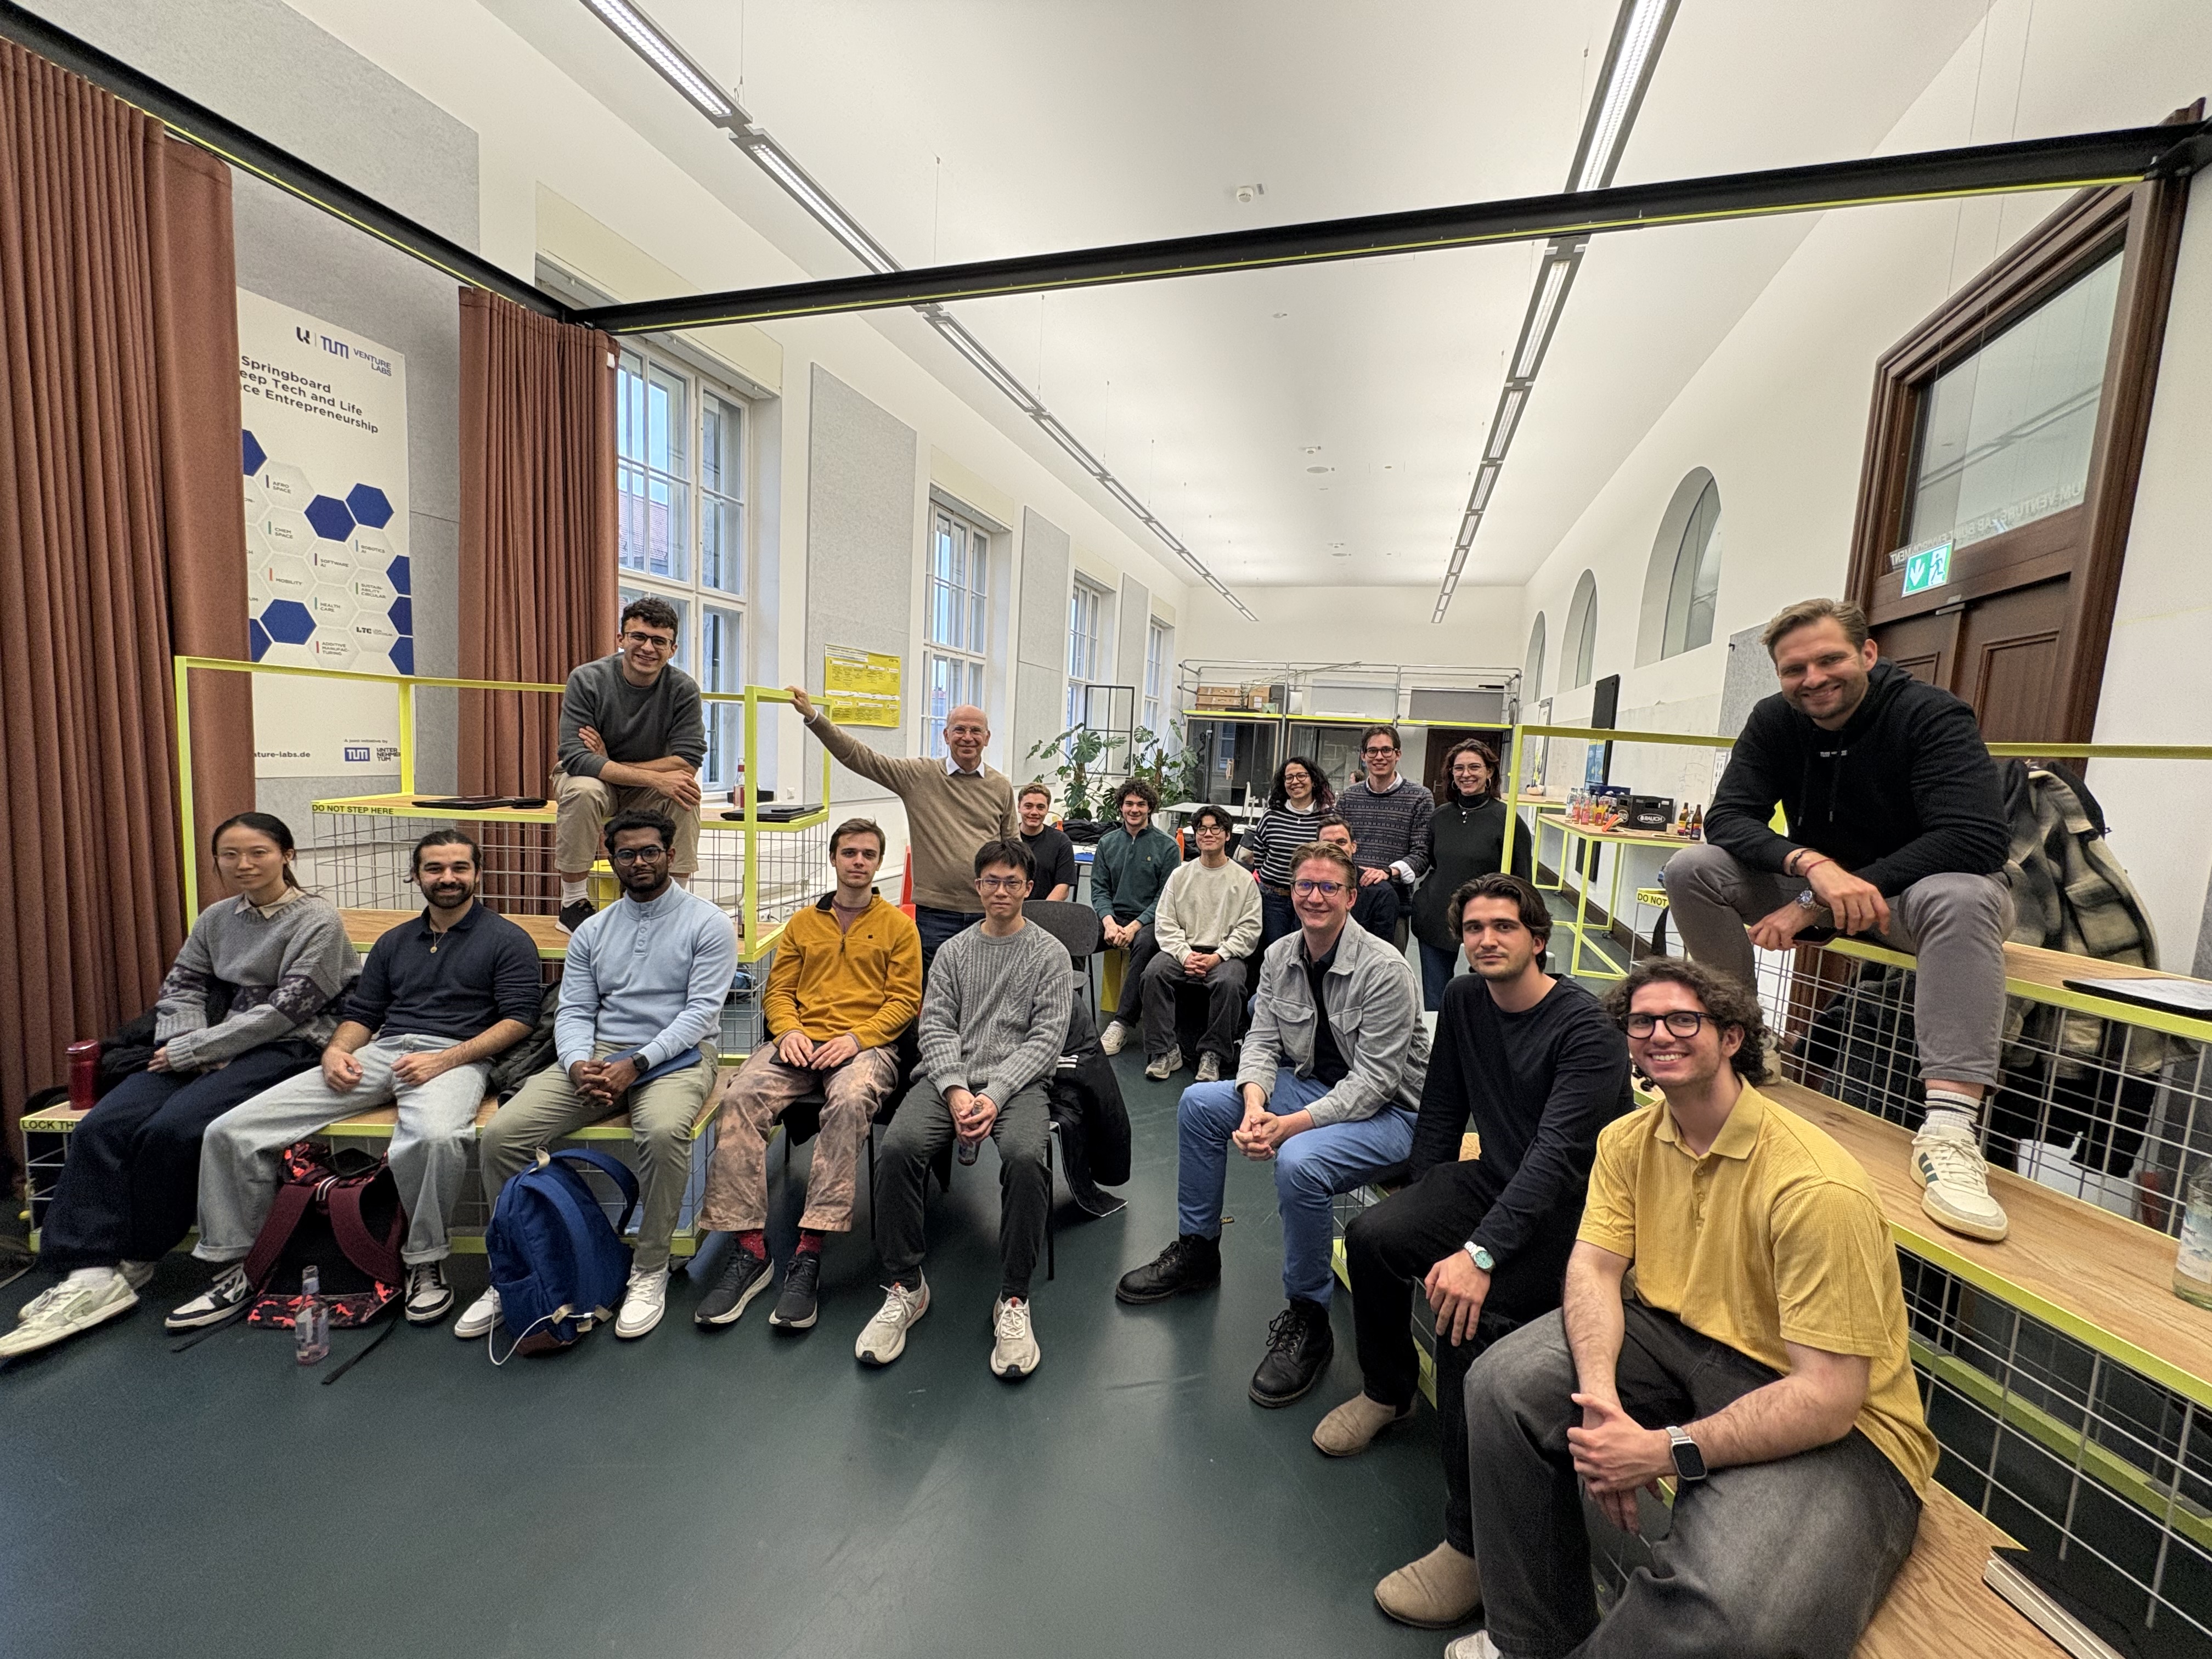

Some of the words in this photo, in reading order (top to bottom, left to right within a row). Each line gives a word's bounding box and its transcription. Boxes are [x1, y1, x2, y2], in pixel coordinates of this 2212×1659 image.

[320, 335, 349, 359] TUM
[353, 347, 392, 370] VENTURE
[241, 355, 331, 394] Springboard
[371, 362, 392, 377] LABS
[240, 370, 267, 386] eep
[272, 378, 307, 398] Tech
[311, 393, 336, 407] and
[340, 400, 363, 416] Life
[242, 384, 261, 396] ce
[266, 389, 379, 434] Entrepreneurship
[320, 558, 349, 568] SOFTWARE
[276, 578, 303, 586] MOBILITY
[346, 749, 368, 760] TUM
[1637, 893, 1649, 902] DO
[1650, 895, 1668, 907] NOT
[21, 1120, 55, 1130] LOCK
[58, 1120, 77, 1130] TH
